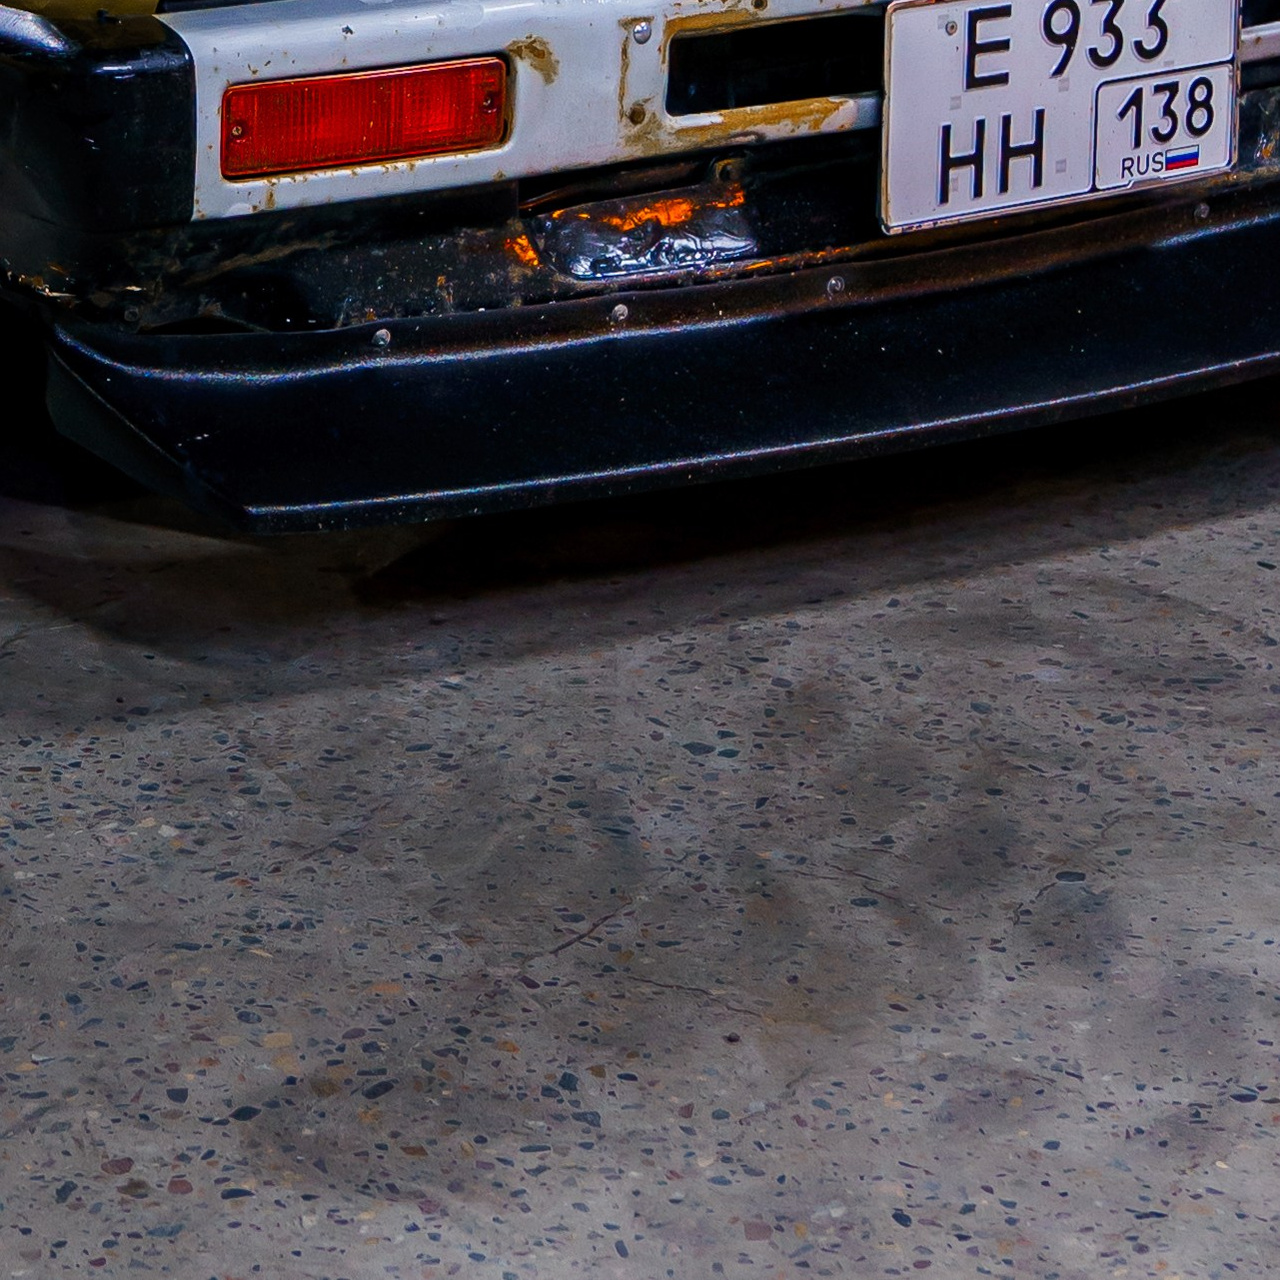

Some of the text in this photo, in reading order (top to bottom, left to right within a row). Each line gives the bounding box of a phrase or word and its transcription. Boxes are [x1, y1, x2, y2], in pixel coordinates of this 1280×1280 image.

[962, 2, 1013, 92] E
[1115, 75, 1216, 150] 138
[937, 107, 1047, 205] HH
[1120, 151, 1164, 179] RUS
